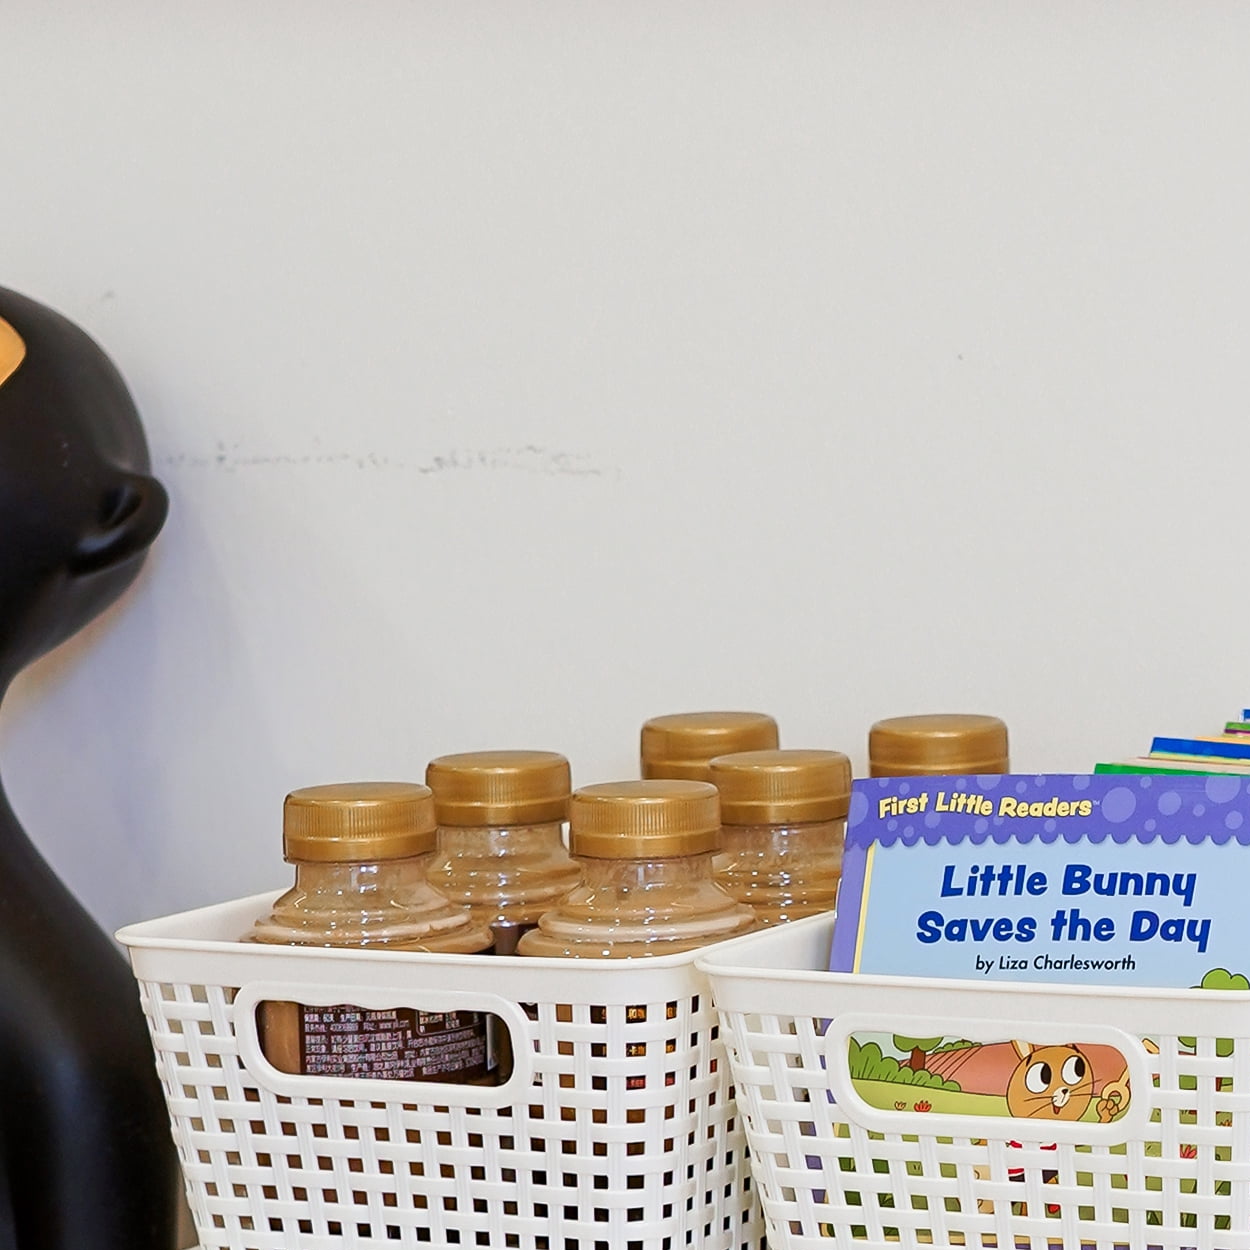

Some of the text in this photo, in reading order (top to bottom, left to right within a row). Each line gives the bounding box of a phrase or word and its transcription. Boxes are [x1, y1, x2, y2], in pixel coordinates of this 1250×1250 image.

[879, 792, 1093, 818] First Little Readers
[940, 864, 1197, 907] Little Bunny
[916, 908, 1211, 953] Saves the Day
[975, 954, 1136, 974] by Liza Charlesworth
